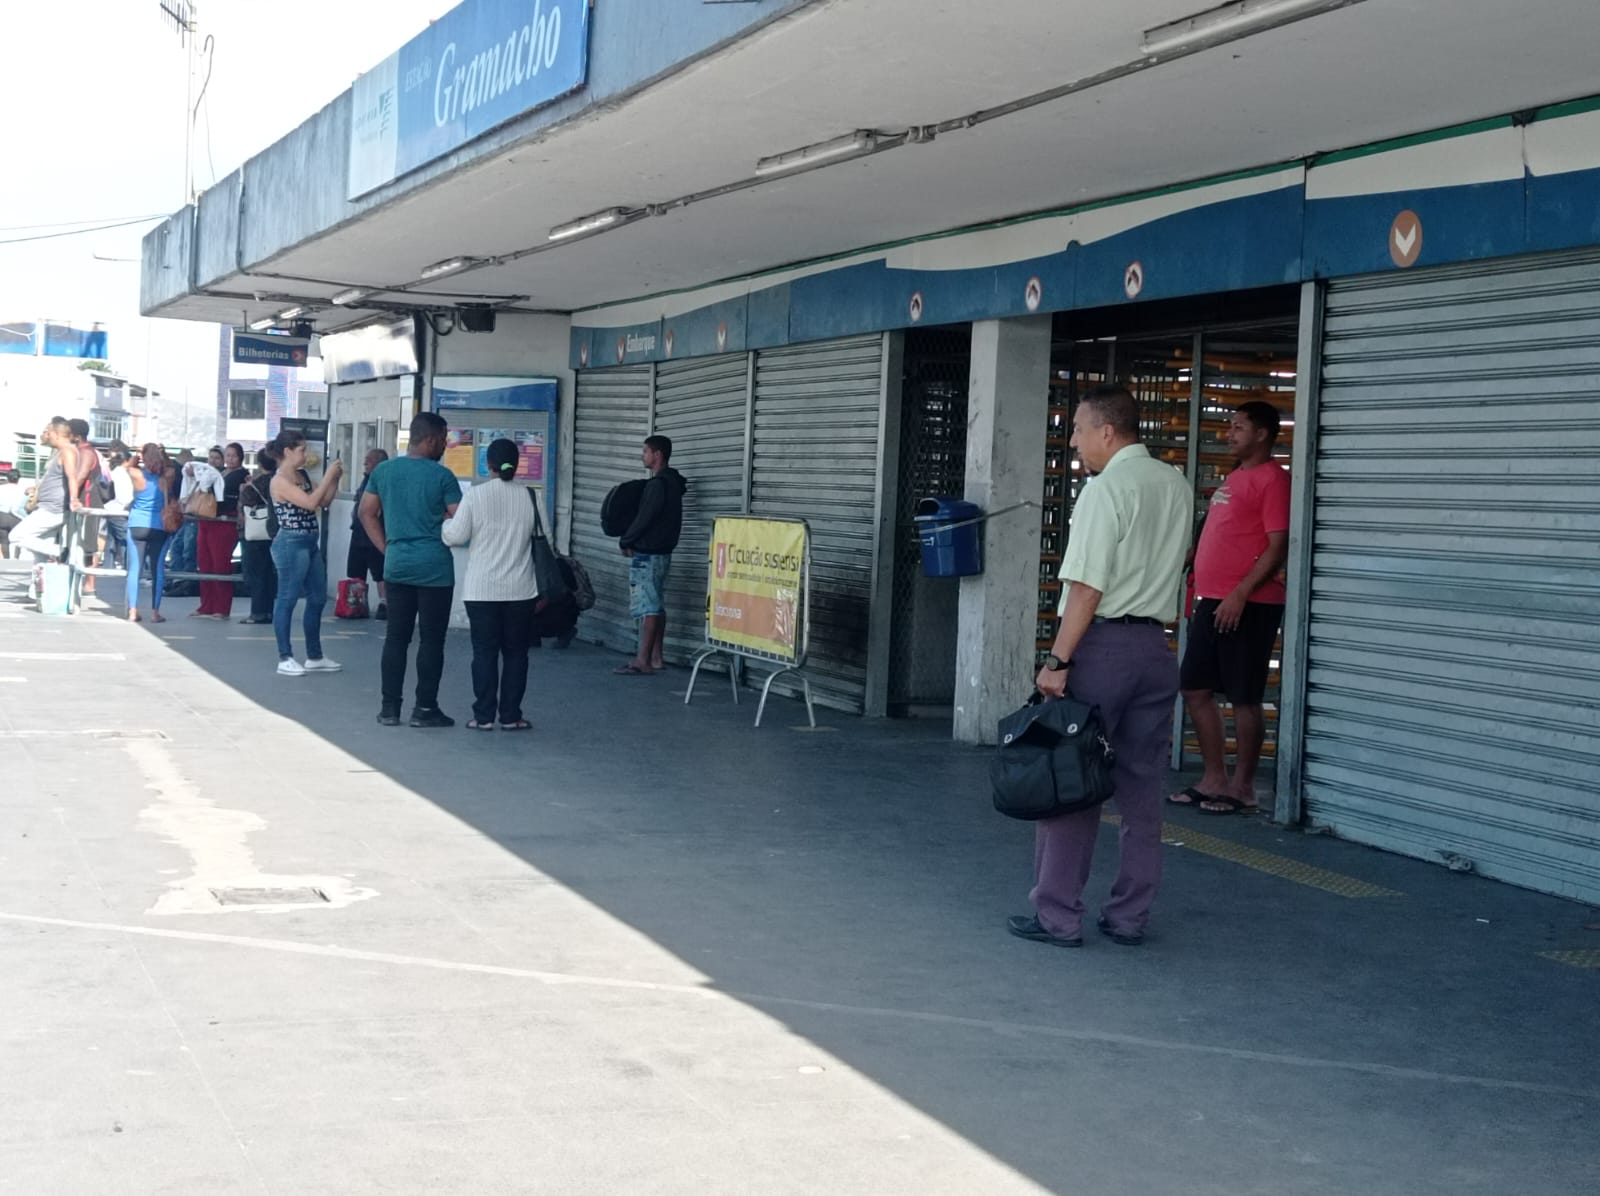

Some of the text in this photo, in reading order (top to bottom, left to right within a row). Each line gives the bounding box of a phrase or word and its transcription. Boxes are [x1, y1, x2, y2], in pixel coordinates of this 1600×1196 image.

[434, 0, 561, 127] Gramacho
[238, 347, 289, 360] Bilheterias
[626, 333, 655, 356] Embarque
